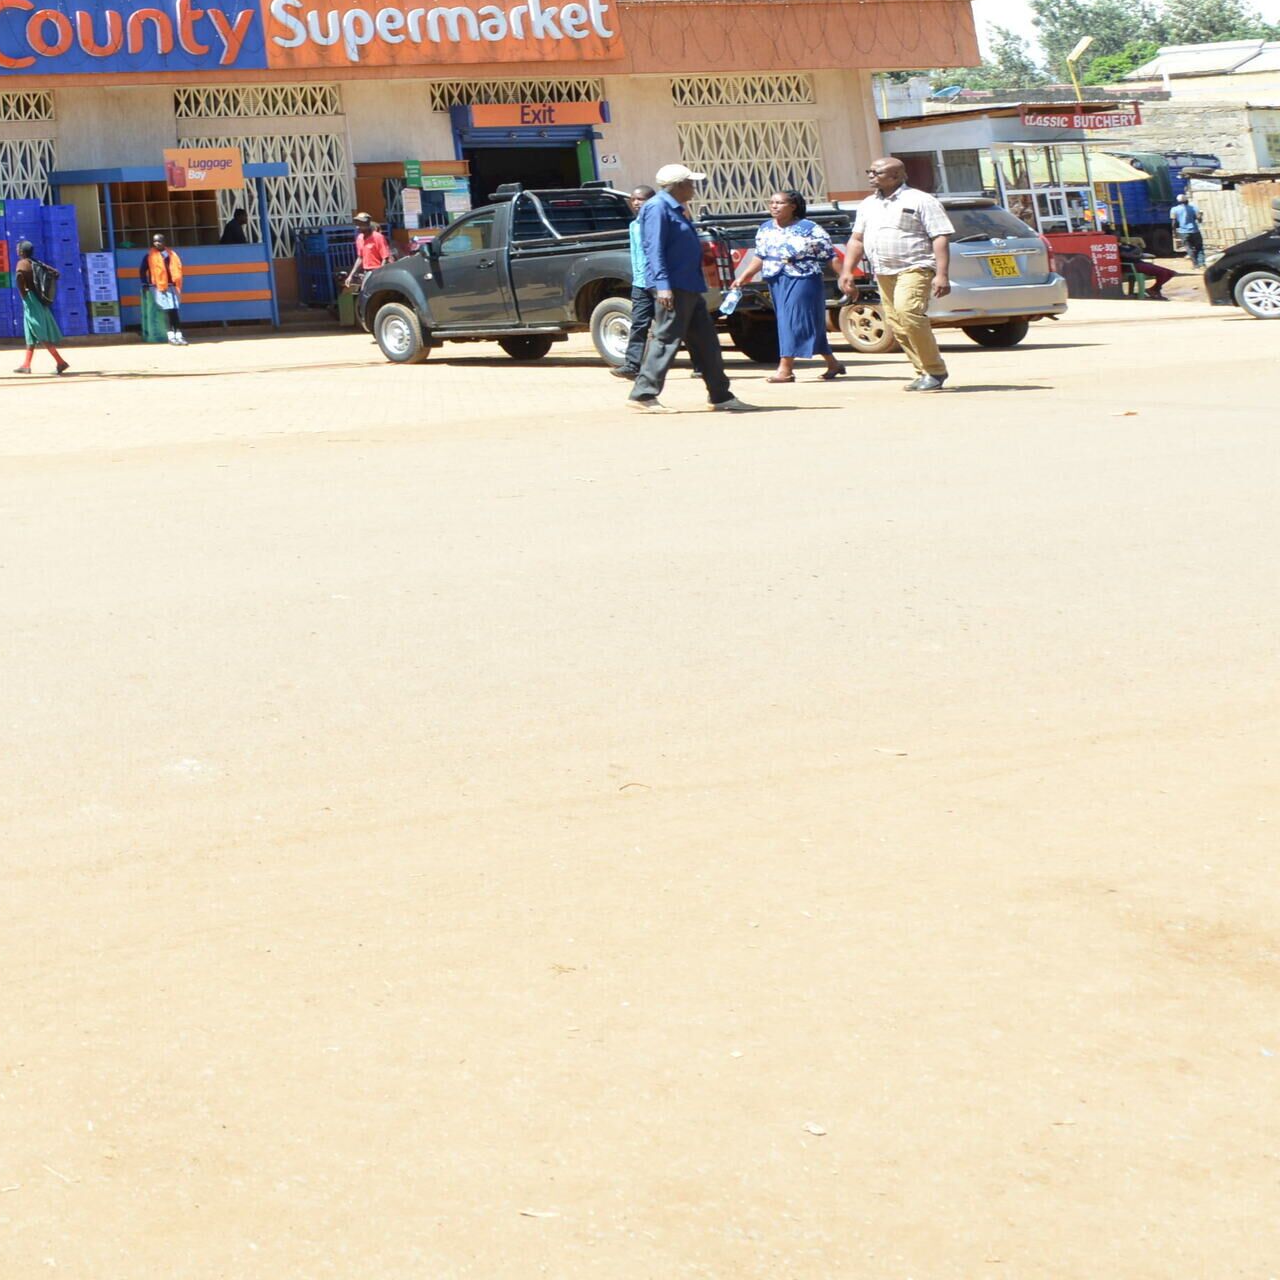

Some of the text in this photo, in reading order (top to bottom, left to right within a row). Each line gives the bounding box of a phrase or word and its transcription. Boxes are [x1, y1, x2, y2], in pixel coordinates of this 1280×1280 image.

[520, 104, 556, 124] Exit
[1073, 114, 1137, 128] BUTCHERY
[188, 158, 233, 170] Luggage
[601, 155, 617, 164] GS
[188, 169, 207, 181] Bay
